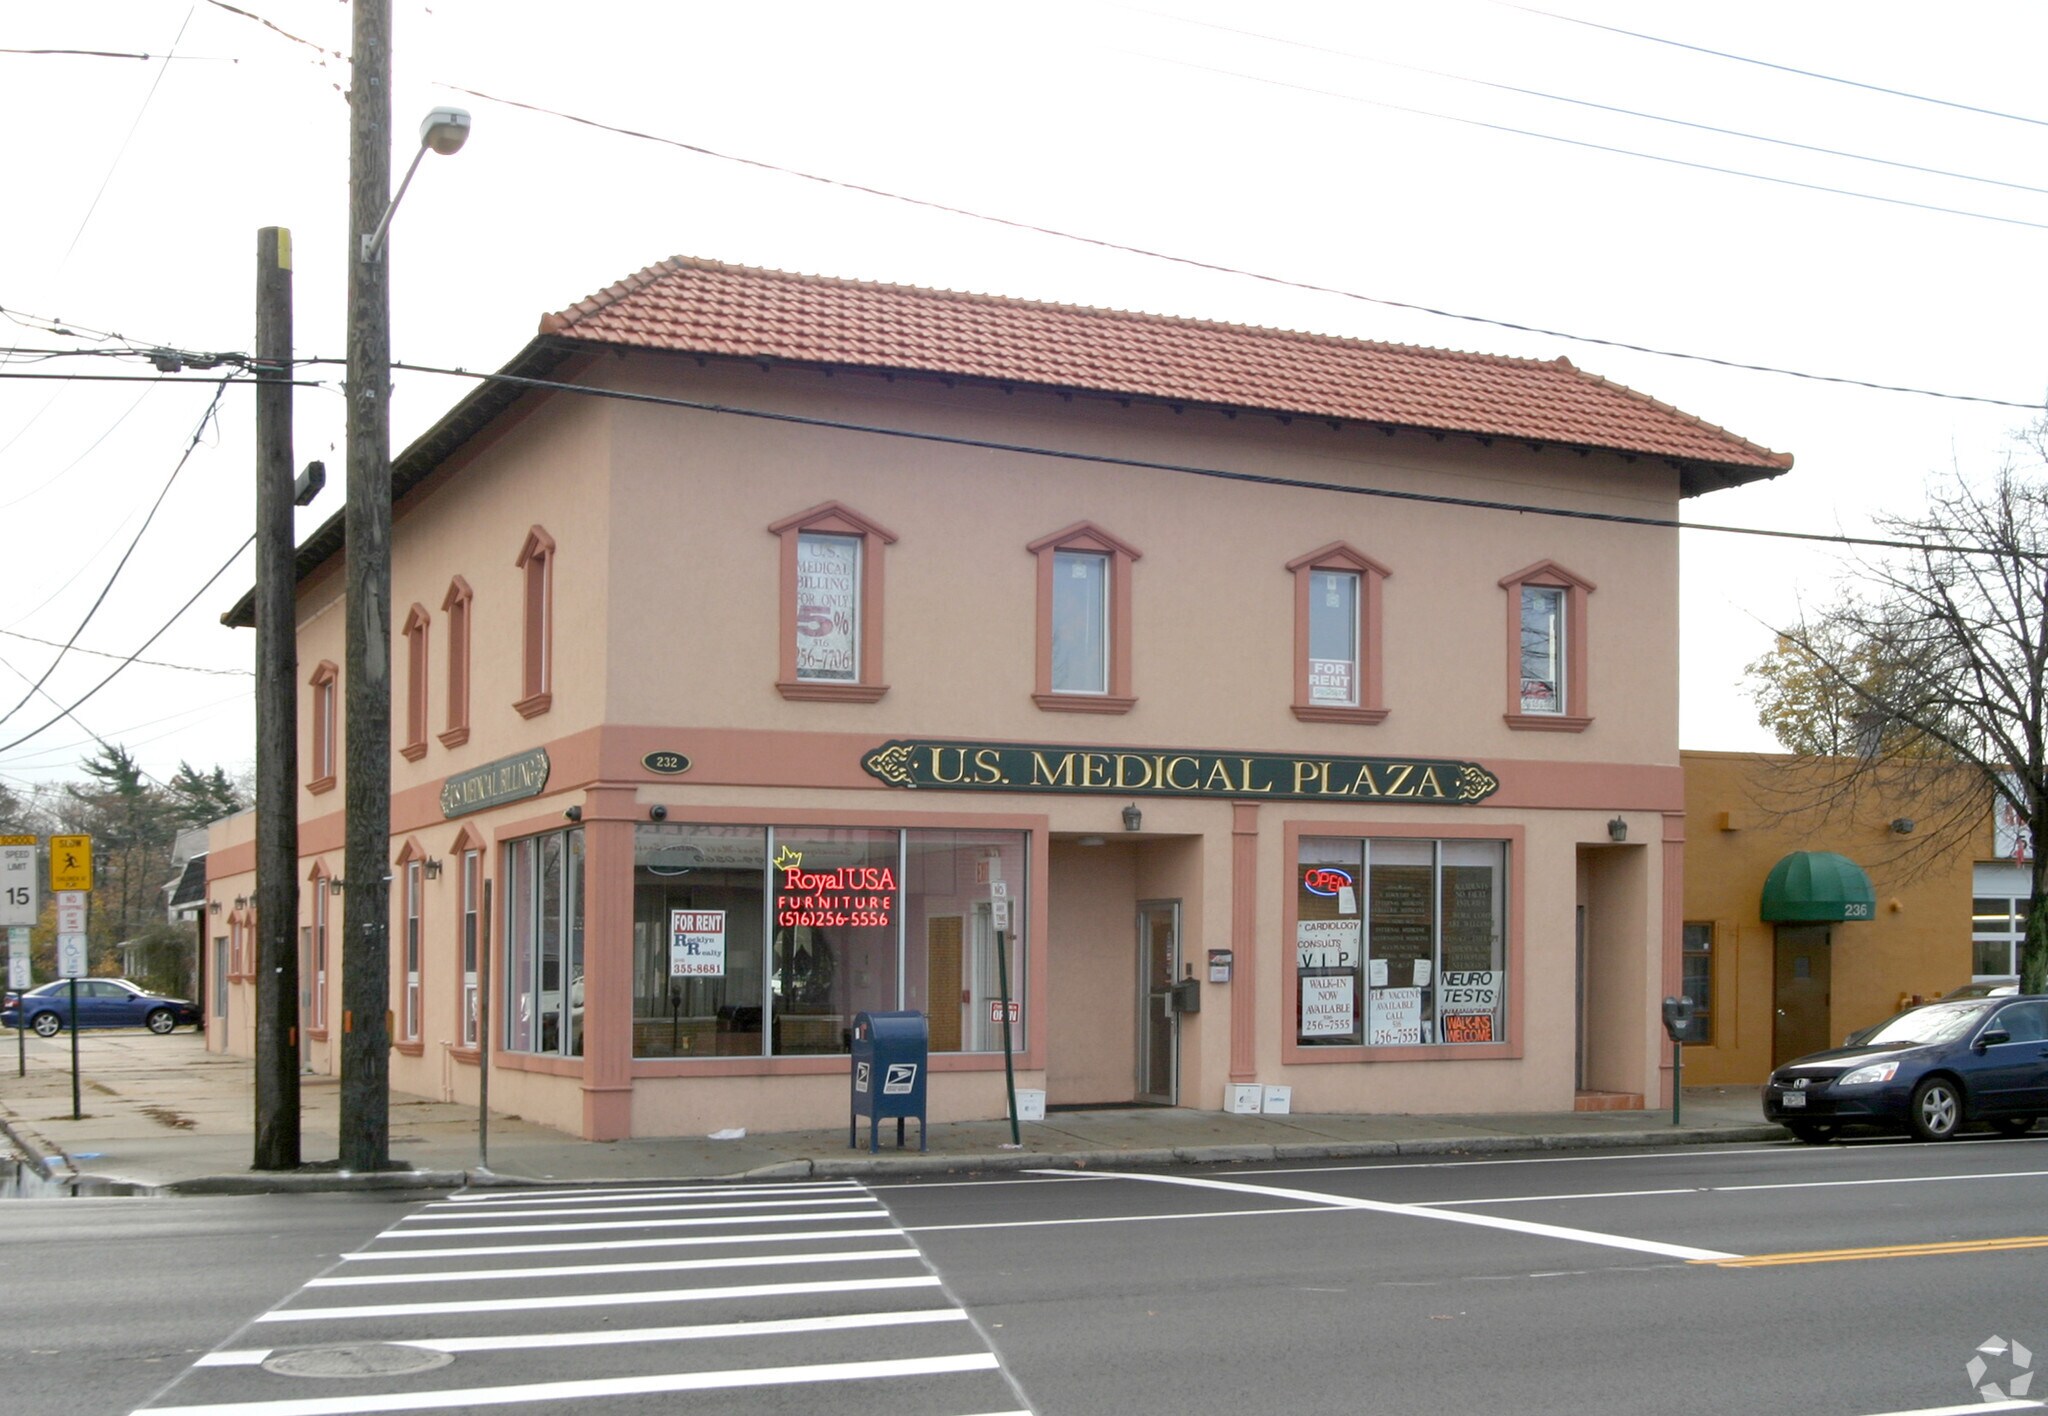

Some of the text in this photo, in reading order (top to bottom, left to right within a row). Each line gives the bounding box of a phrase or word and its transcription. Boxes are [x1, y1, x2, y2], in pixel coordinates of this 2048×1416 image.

[810, 544, 840, 558] U.S.
[821, 593, 849, 608] ONLY
[1314, 663, 1346, 675] FOR
[1309, 675, 1350, 687] RENT
[656, 756, 678, 769] 232
[928, 746, 1446, 798] U.S. MEDICAL PLAZA
[59, 839, 82, 848] SLOW
[5, 850, 30, 859] SPEED
[7, 862, 27, 871] LIMIT
[784, 867, 897, 896] Royal USA
[5, 886, 31, 905] 15
[995, 885, 1005, 896] NO
[66, 895, 77, 903] NO
[778, 896, 891, 909] FURNITURE
[1844, 904, 1868, 917] 236
[674, 914, 722, 931] FOR RENT
[779, 911, 889, 926] (516)256-5556
[1304, 922, 1360, 932] CARDIOLOGY
[687, 942, 722, 957] Realty
[1297, 939, 1342, 949] CONSULTS
[674, 964, 721, 974] 355-8681
[1310, 979, 1347, 989] WALK-IN
[1441, 972, 1493, 986] NEURO
[1318, 991, 1338, 1000] NOW
[1444, 988, 1494, 1004] TESTS
[1306, 1003, 1351, 1014] AVAILABLE
[1377, 1001, 1415, 1011] AVAILABLE
[1385, 1011, 1404, 1021] CALL
[1306, 1019, 1350, 1030] 256-7555
[1447, 1016, 1490, 1030] WALK-INS
[1374, 1028, 1419, 1045] 256-7555
[1448, 1029, 1491, 1042] WELCOME
